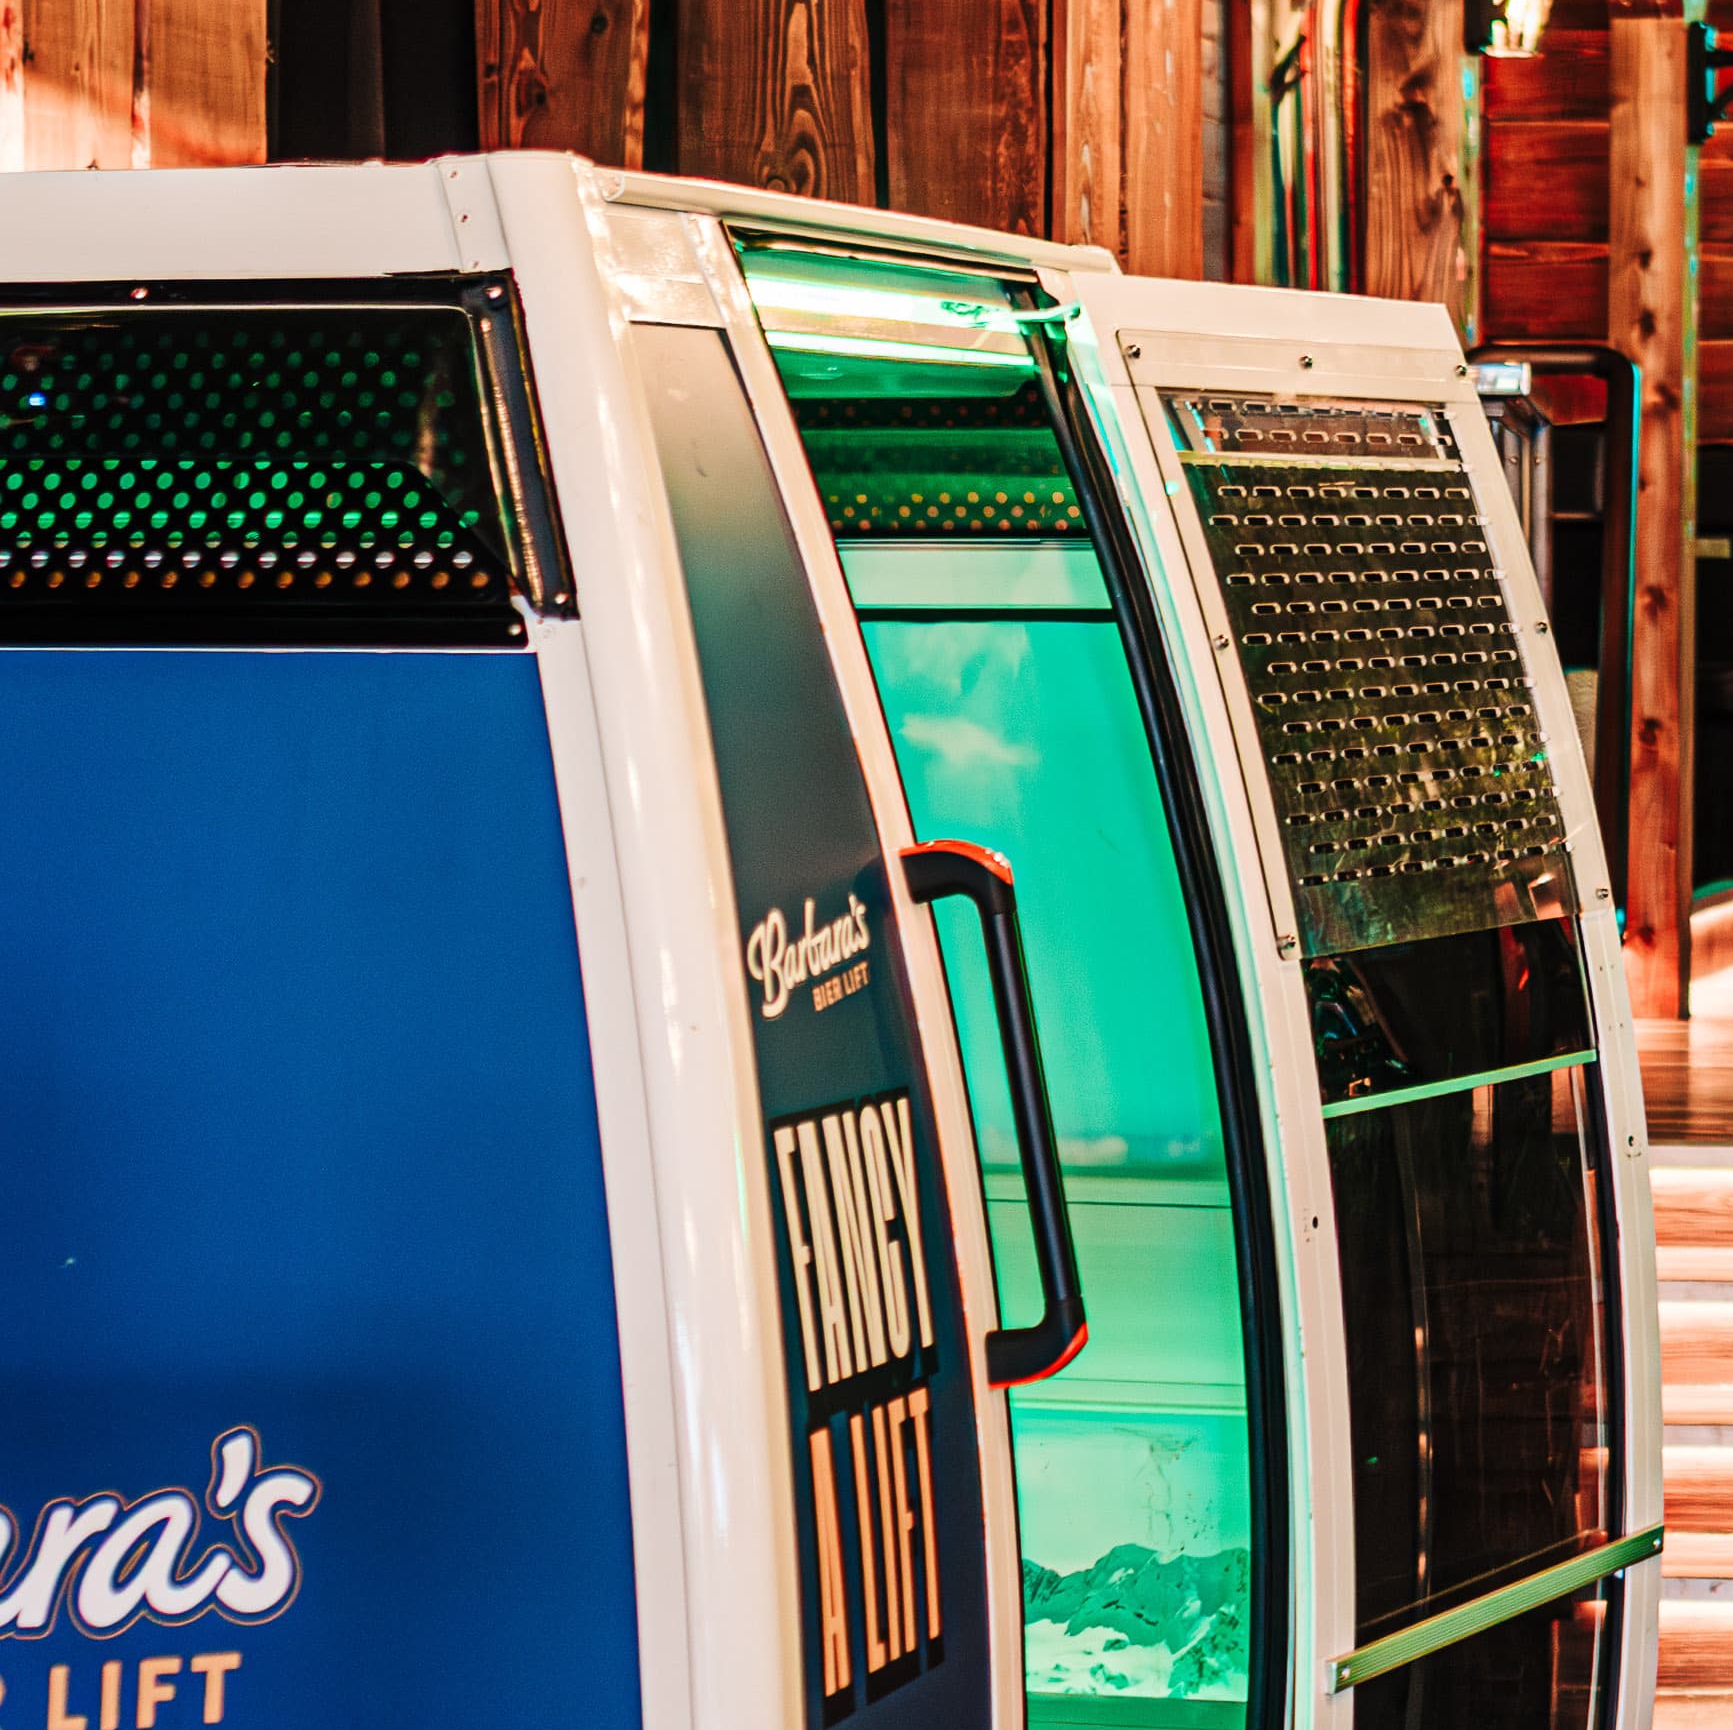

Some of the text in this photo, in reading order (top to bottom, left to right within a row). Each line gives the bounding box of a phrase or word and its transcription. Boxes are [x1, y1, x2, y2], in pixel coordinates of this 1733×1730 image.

[747, 893, 870, 1018] Barbara's
[812, 961, 869, 1012] BIER LIFT
[773, 1097, 935, 1392] FANCY
[0, 1431, 316, 1631] ra's
[809, 1386, 941, 1698] A LIFT
